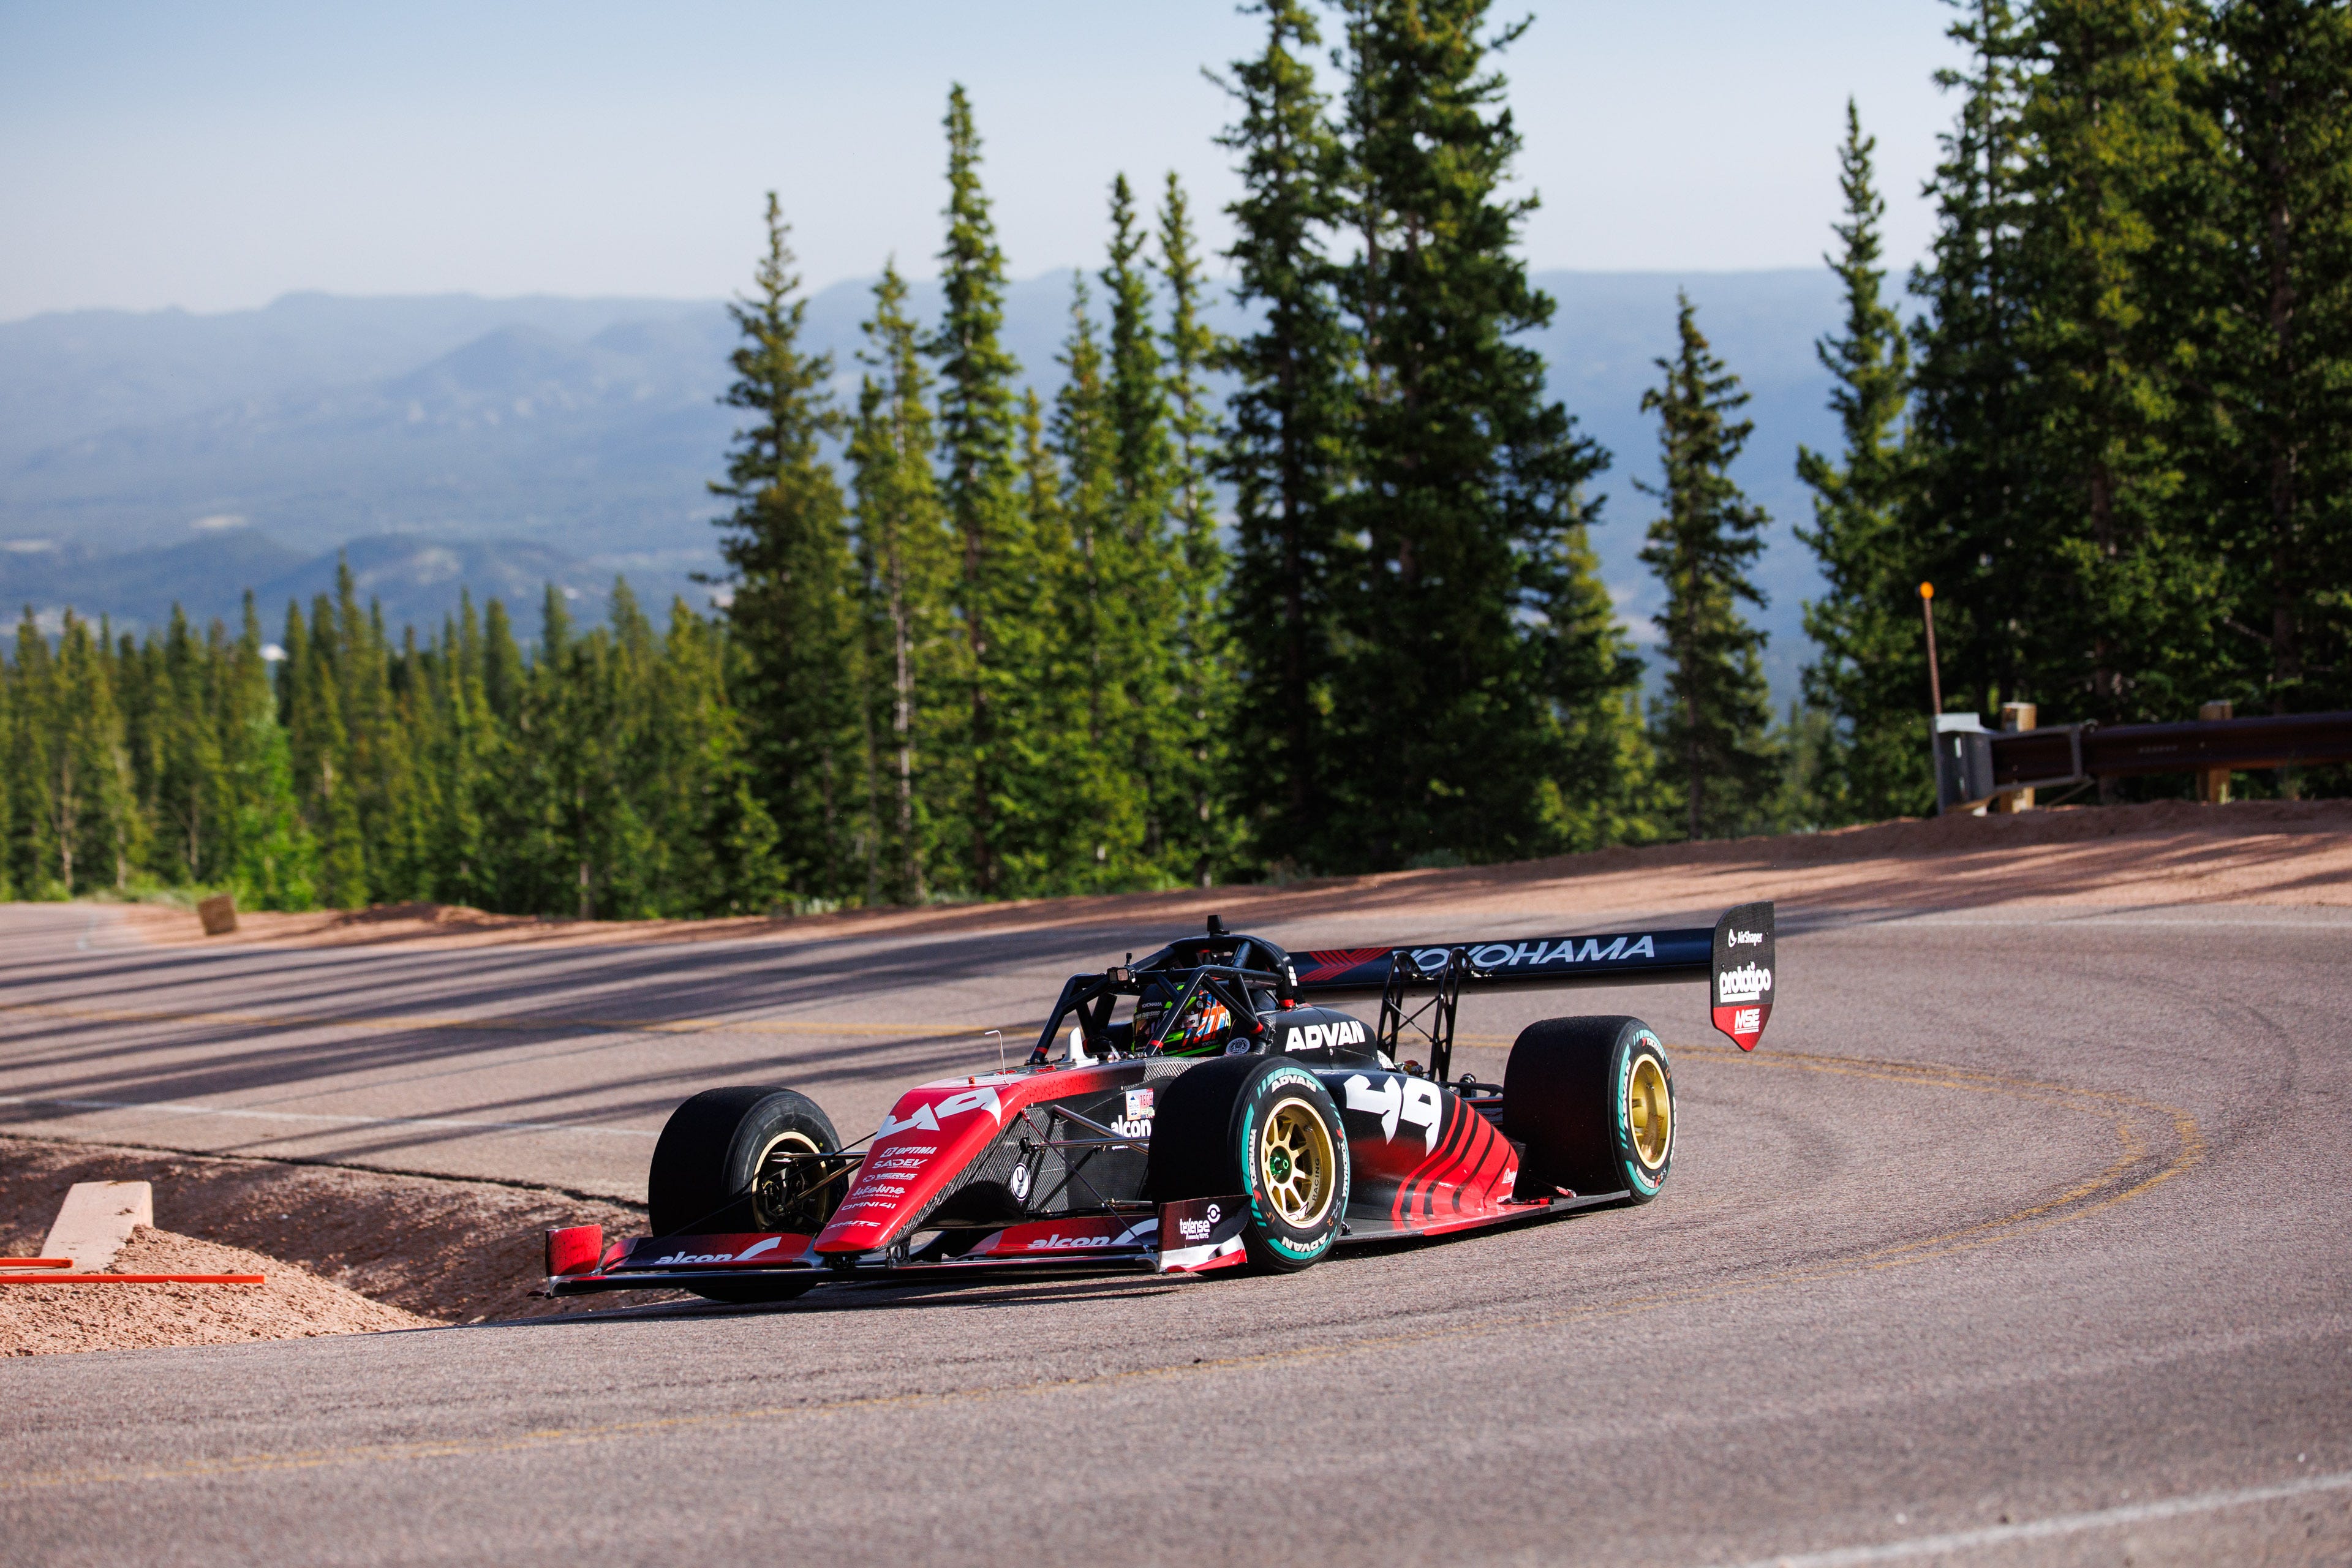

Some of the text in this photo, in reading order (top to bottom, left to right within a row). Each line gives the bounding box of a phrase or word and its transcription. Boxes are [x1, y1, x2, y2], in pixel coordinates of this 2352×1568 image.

[1737, 930, 1763, 946] AirShaper
[1719, 961, 1771, 1003] prototipo
[1735, 1009, 1760, 1028] MSE
[1285, 1020, 1366, 1052] ADVAN
[1272, 1075, 1316, 1093] ADVAN
[1140, 1094, 1153, 1106] TECH
[1110, 1115, 1152, 1138] alcon
[895, 1147, 938, 1155] OPTIMA
[1248, 1128, 1257, 1189] YOKOHAMA
[872, 1158, 929, 1169] SADEV
[1340, 1140, 1350, 1197] YOKOHAMA
[1180, 1218, 1210, 1240] texense
[1028, 1234, 1110, 1248] alcon
[1281, 1232, 1327, 1253] ADVAN
[654, 1251, 733, 1264] alcon
